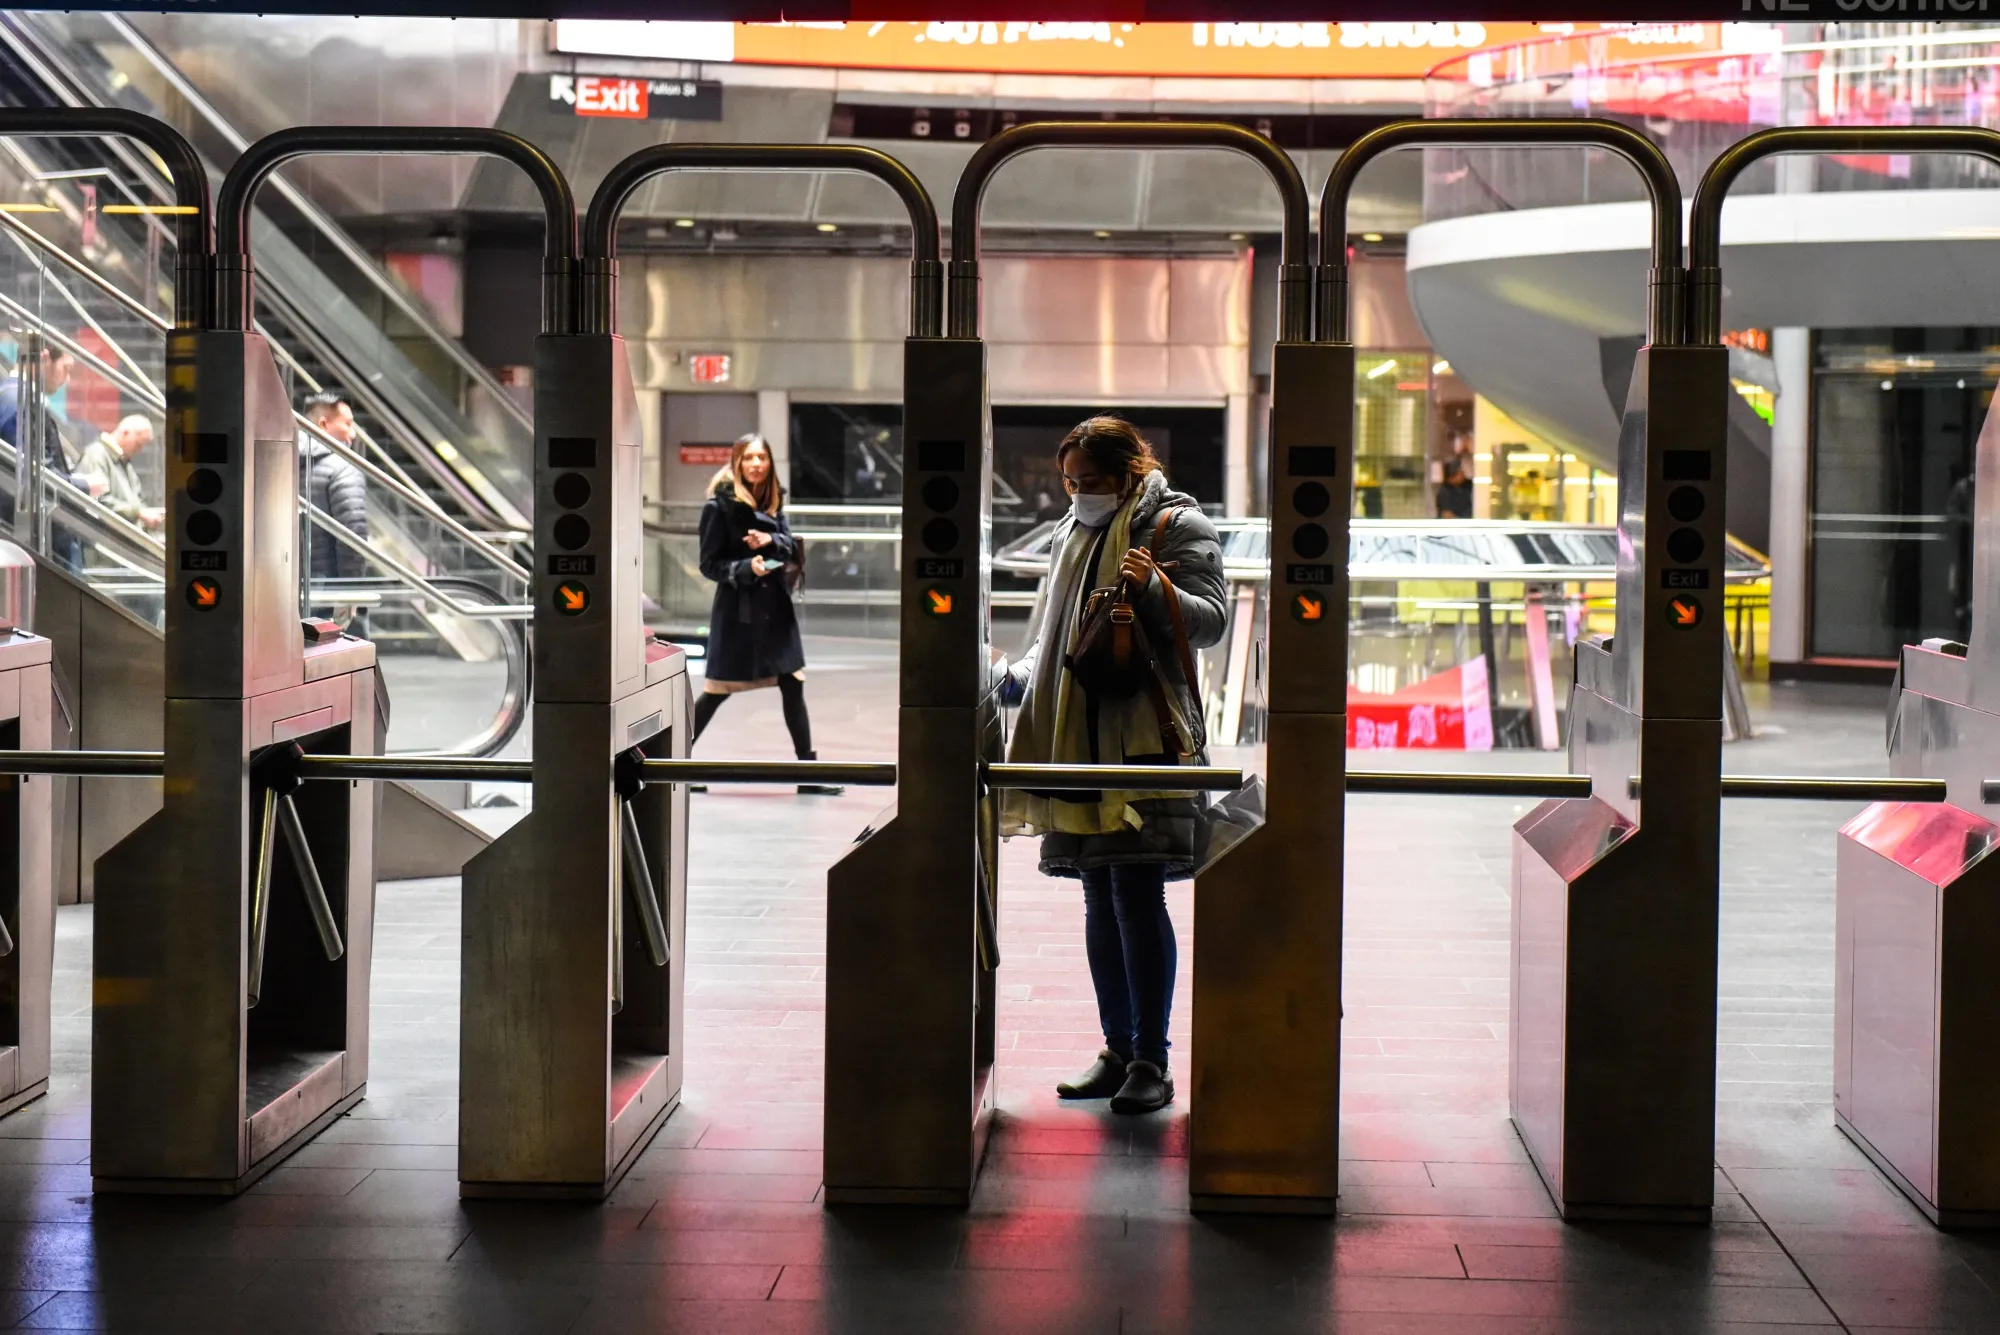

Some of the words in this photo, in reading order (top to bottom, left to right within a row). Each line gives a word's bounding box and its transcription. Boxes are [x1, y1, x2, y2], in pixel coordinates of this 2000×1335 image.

[576, 77, 640, 112] Exit
[190, 553, 220, 568] Exit
[558, 557, 588, 573] Exit
[925, 561, 956, 576] Exit
[1295, 566, 1325, 582] Exit
[1668, 571, 1700, 587] Exit
